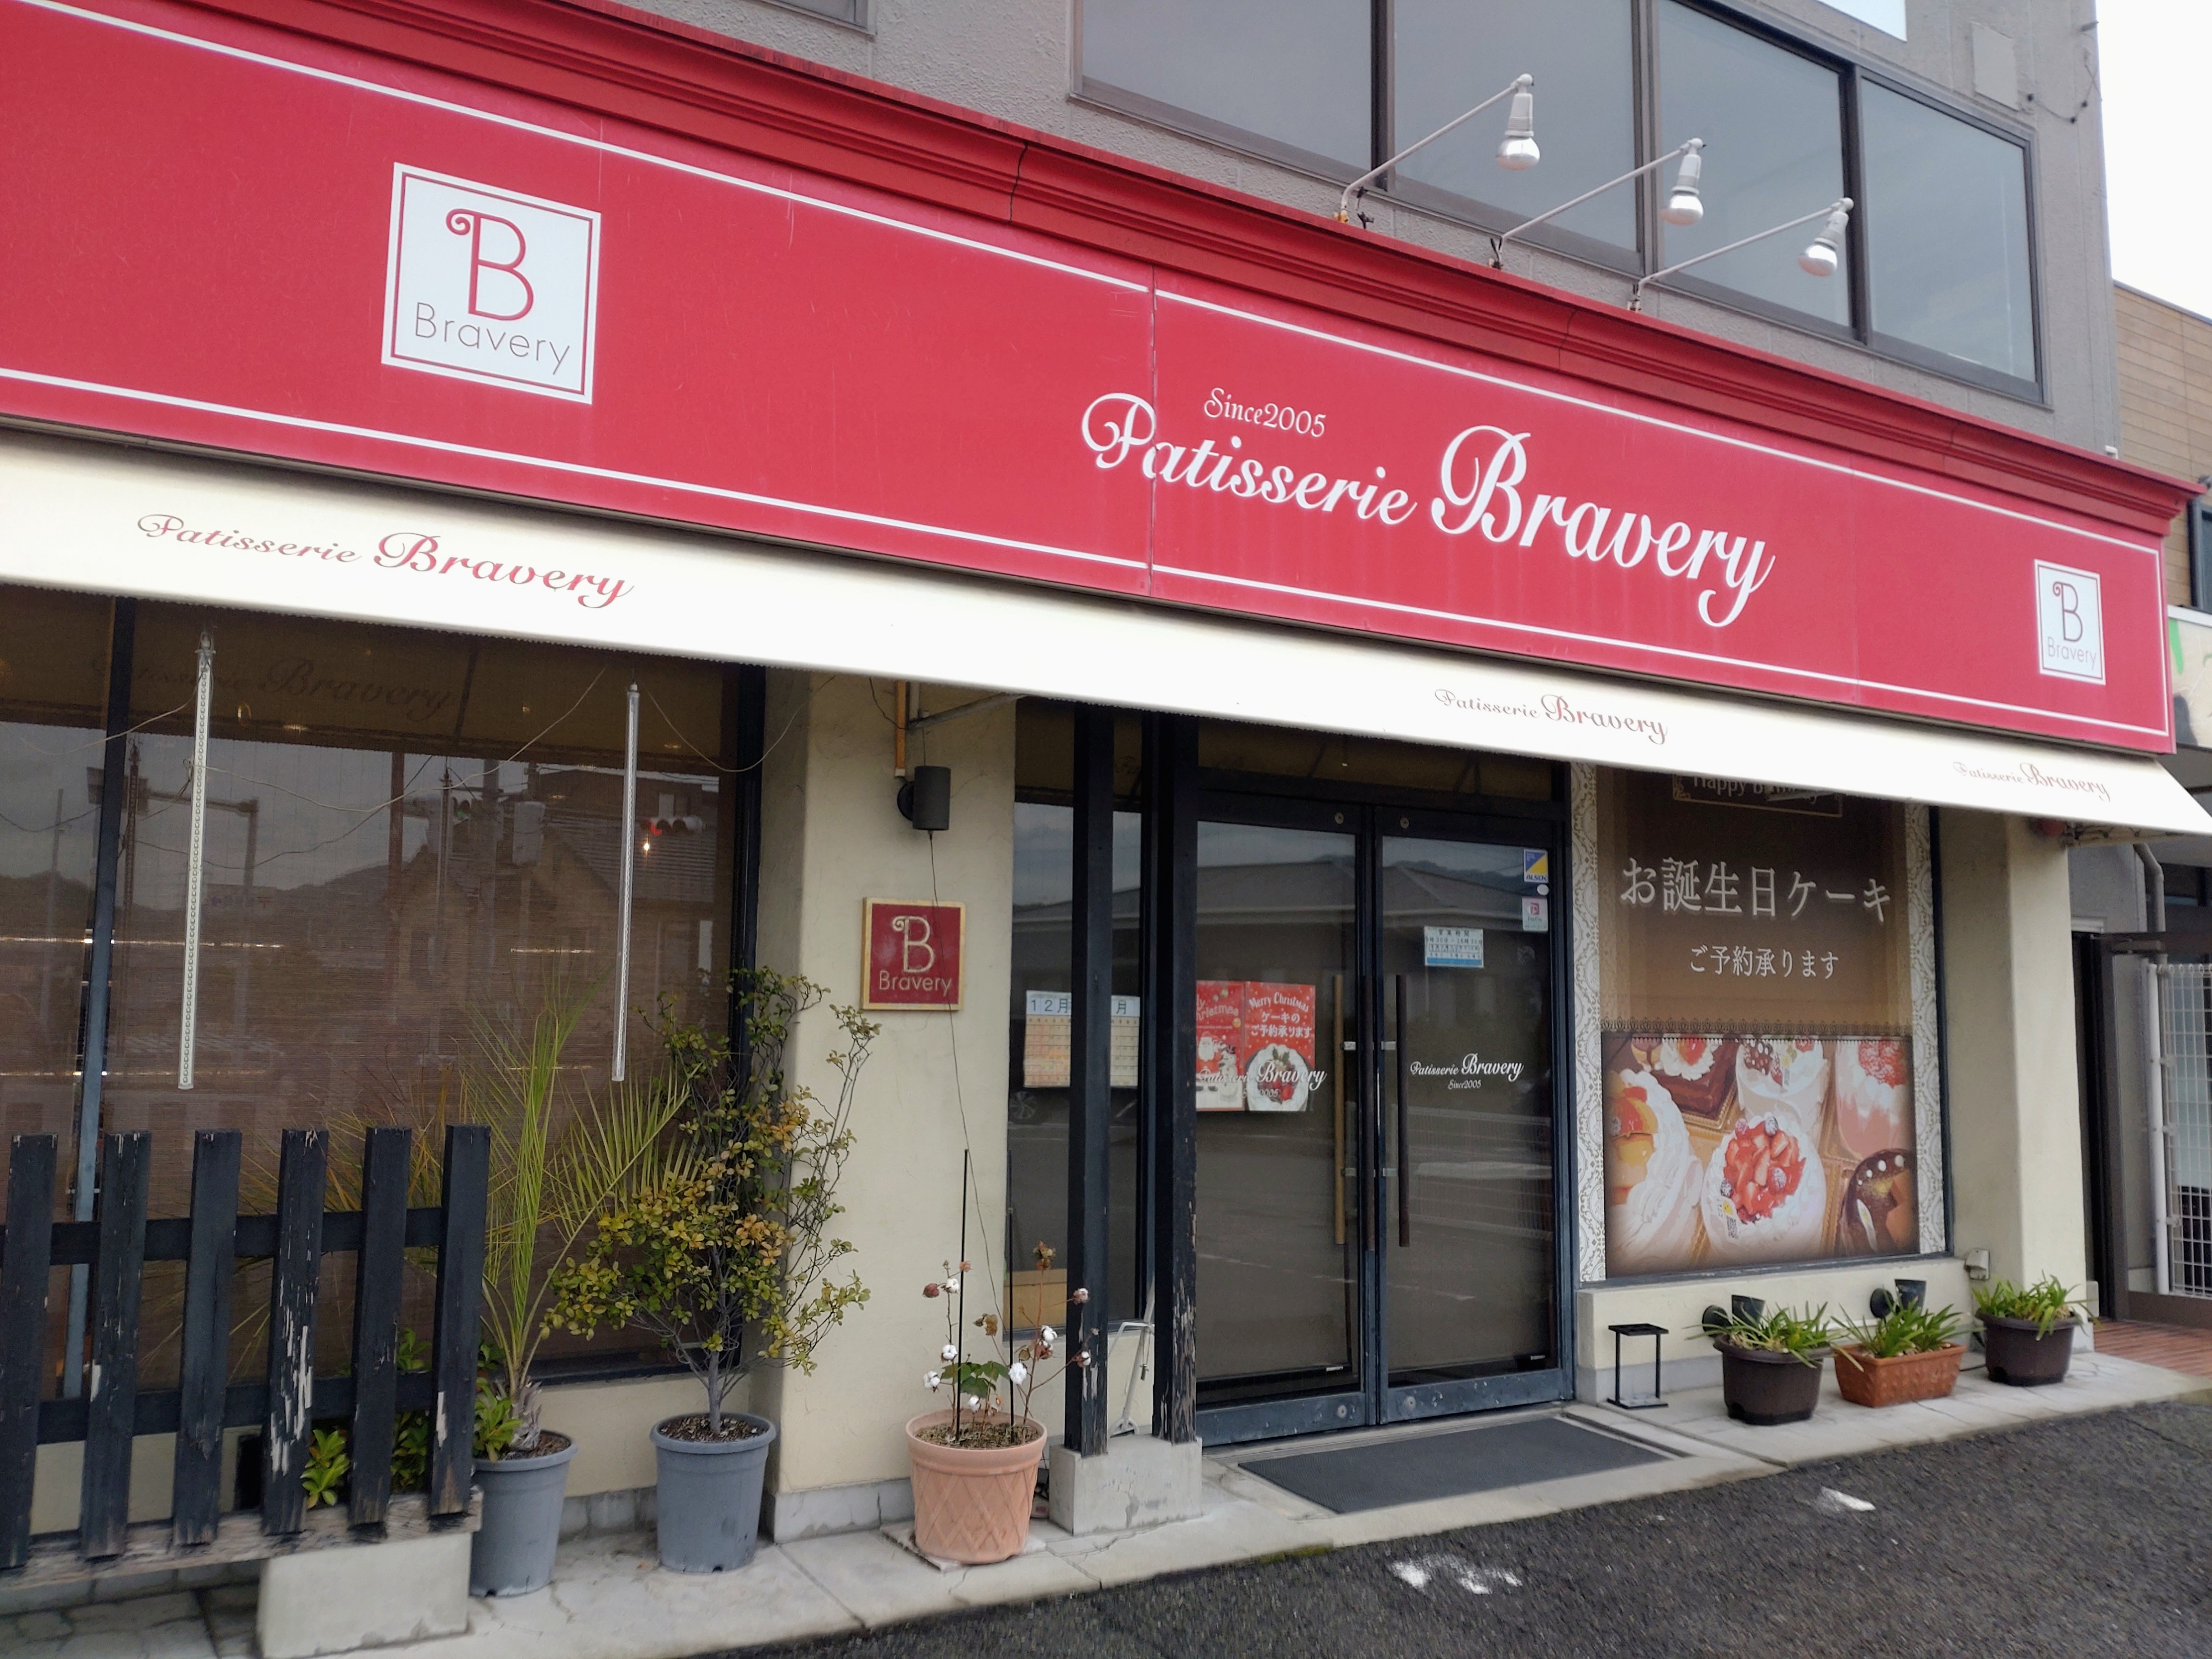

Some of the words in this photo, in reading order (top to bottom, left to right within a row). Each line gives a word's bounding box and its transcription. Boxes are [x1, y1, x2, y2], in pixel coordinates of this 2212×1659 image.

[446, 208, 534, 321] B
[415, 301, 570, 375] Bravery
[1203, 388, 1327, 438] Since2005
[1081, 393, 1417, 525] Patisserie
[1431, 425, 1776, 627] Bravery
[137, 514, 362, 563] Patisserie
[373, 532, 635, 609] Bravery
[2052, 581, 2083, 642] B
[2047, 636, 2098, 671] Bravery
[1434, 689, 1540, 718] Patisserie
[1541, 694, 1668, 745] Bravery
[1953, 761, 2024, 784] Patisserie
[2020, 763, 2111, 803] Bravery
[1620, 856, 1890, 922] お誕生日ケーキ
[892, 915, 934, 973] B
[1691, 945, 1839, 979] ご予約承ります
[879, 970, 952, 997] Bravery
[1248, 997, 1272, 1009] Merry
[1273, 992, 1310, 1013] Christmas
[1251, 1025, 1312, 1038] ご予約承ります
[1261, 1011, 1301, 1024] ケーキの
[1198, 1068, 1250, 1083] Patisseri
[1410, 1061, 1459, 1076] Patisserie
[1461, 1053, 1525, 1082] Bravery
[1448, 1079, 1482, 1091] Since2005
